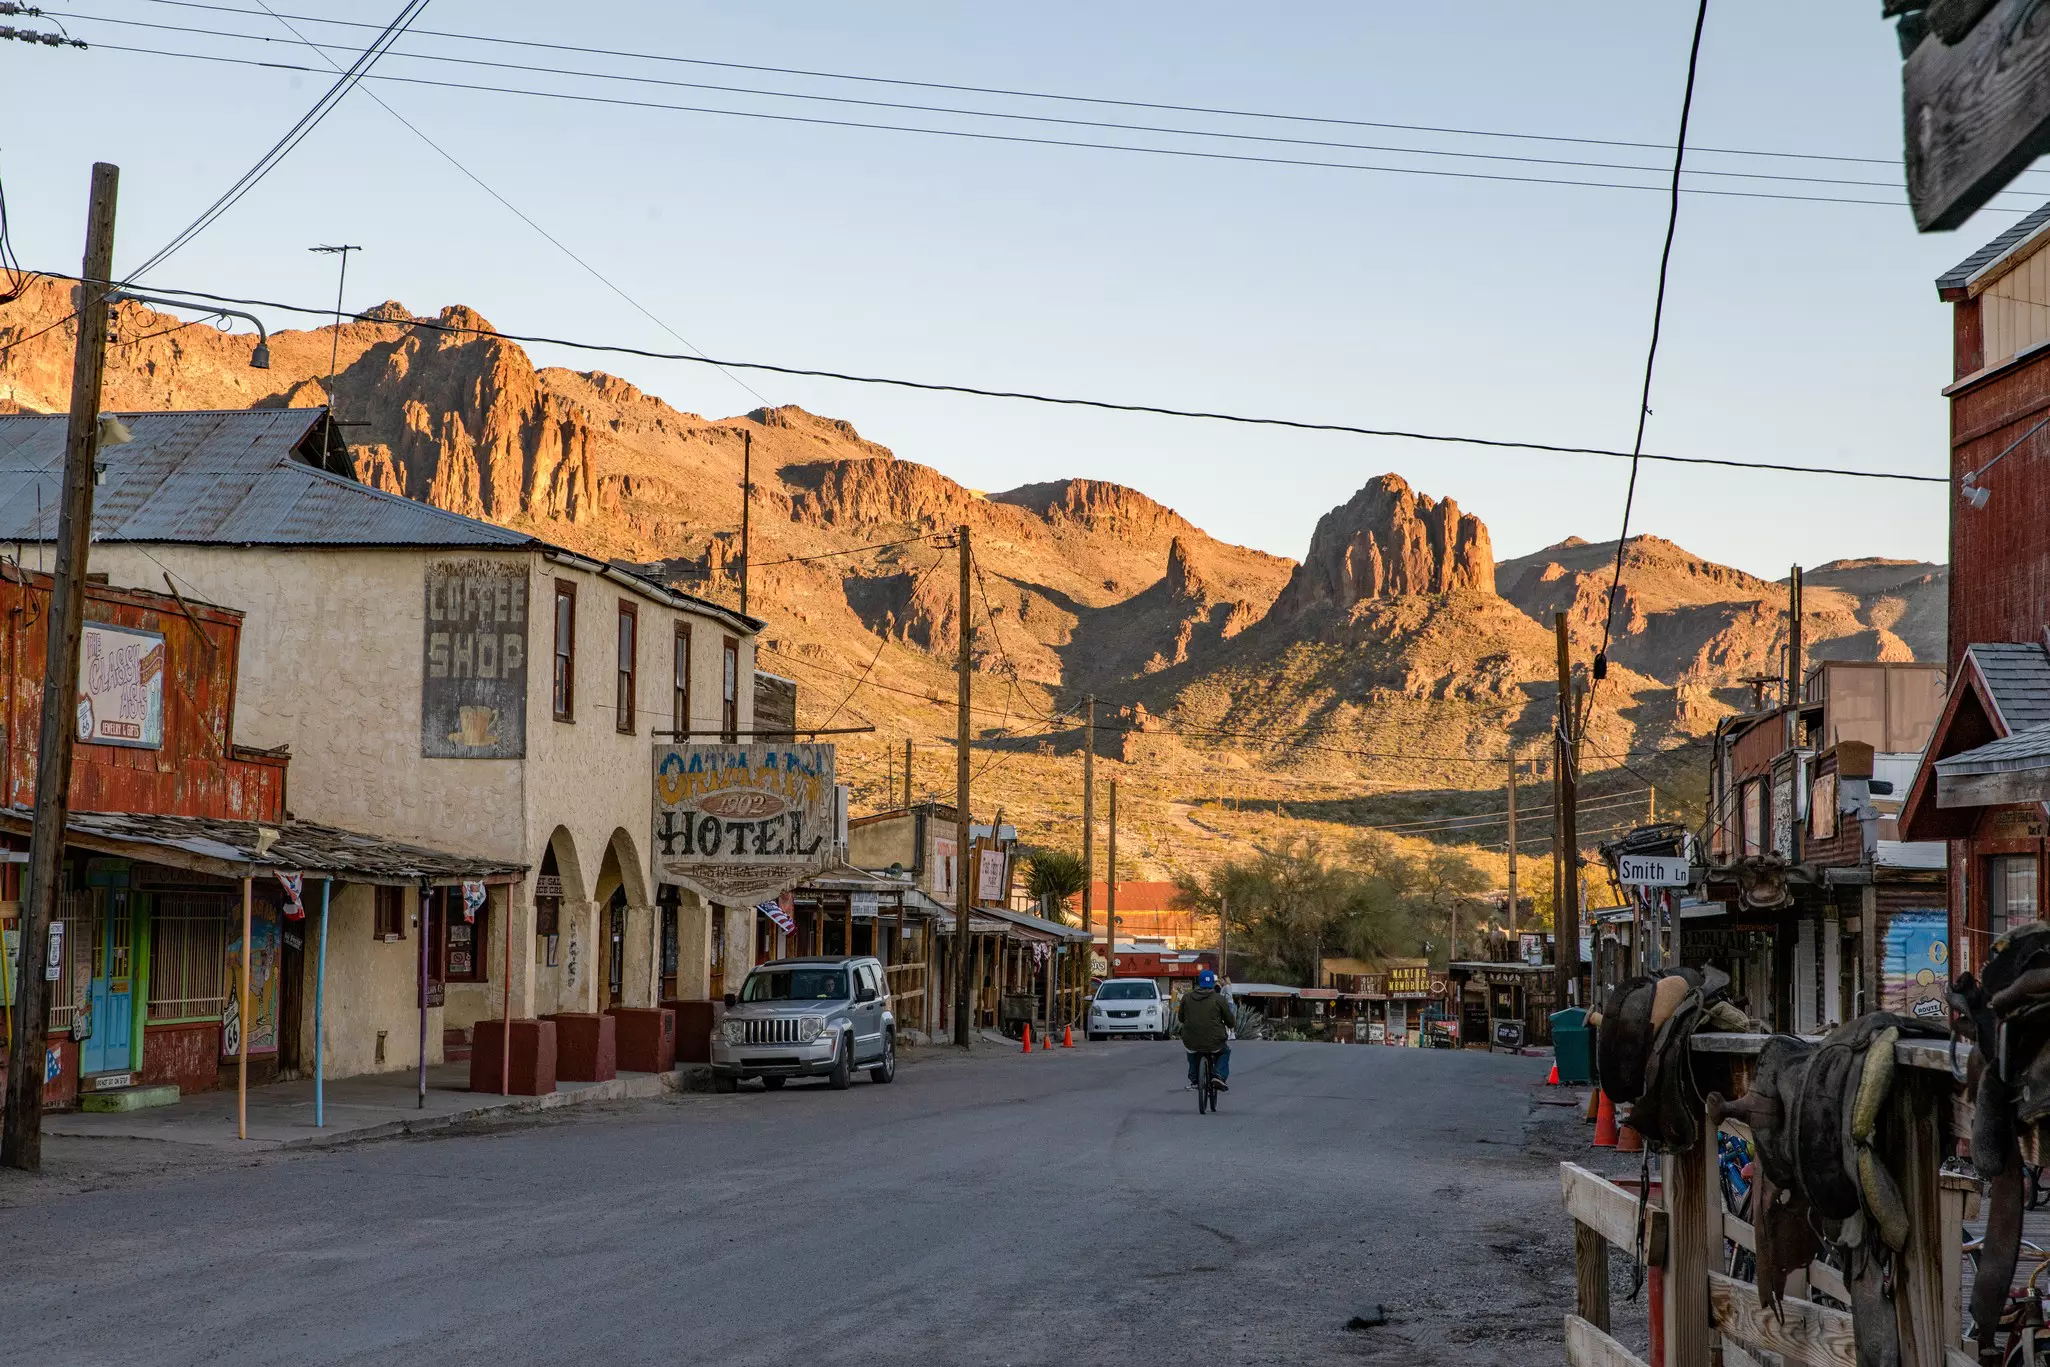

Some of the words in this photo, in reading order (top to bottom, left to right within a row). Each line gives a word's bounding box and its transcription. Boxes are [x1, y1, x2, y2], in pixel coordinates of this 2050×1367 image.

[429, 575, 525, 622] COFFEE
[87, 632, 102, 659] THE
[429, 632, 523, 679] SHOP
[89, 644, 140, 695] CLASSY
[120, 683, 148, 720] ASS
[83, 720, 90, 733] 66
[103, 722, 121, 736] JEWELRY
[127, 724, 140, 737] GIFTS
[657, 752, 823, 806] OATMAN
[716, 795, 766, 815] 1902
[658, 811, 823, 856] HOTEL
[1622, 861, 1664, 880] Smith
[1675, 869, 1686, 881] Ln
[549, 886, 563, 894] CRE
[1392, 968, 1427, 979] MAKING
[1388, 980, 1430, 991] MEMORIES
[1918, 1004, 1938, 1013] ROUTE
[228, 1023, 238, 1050] 66
